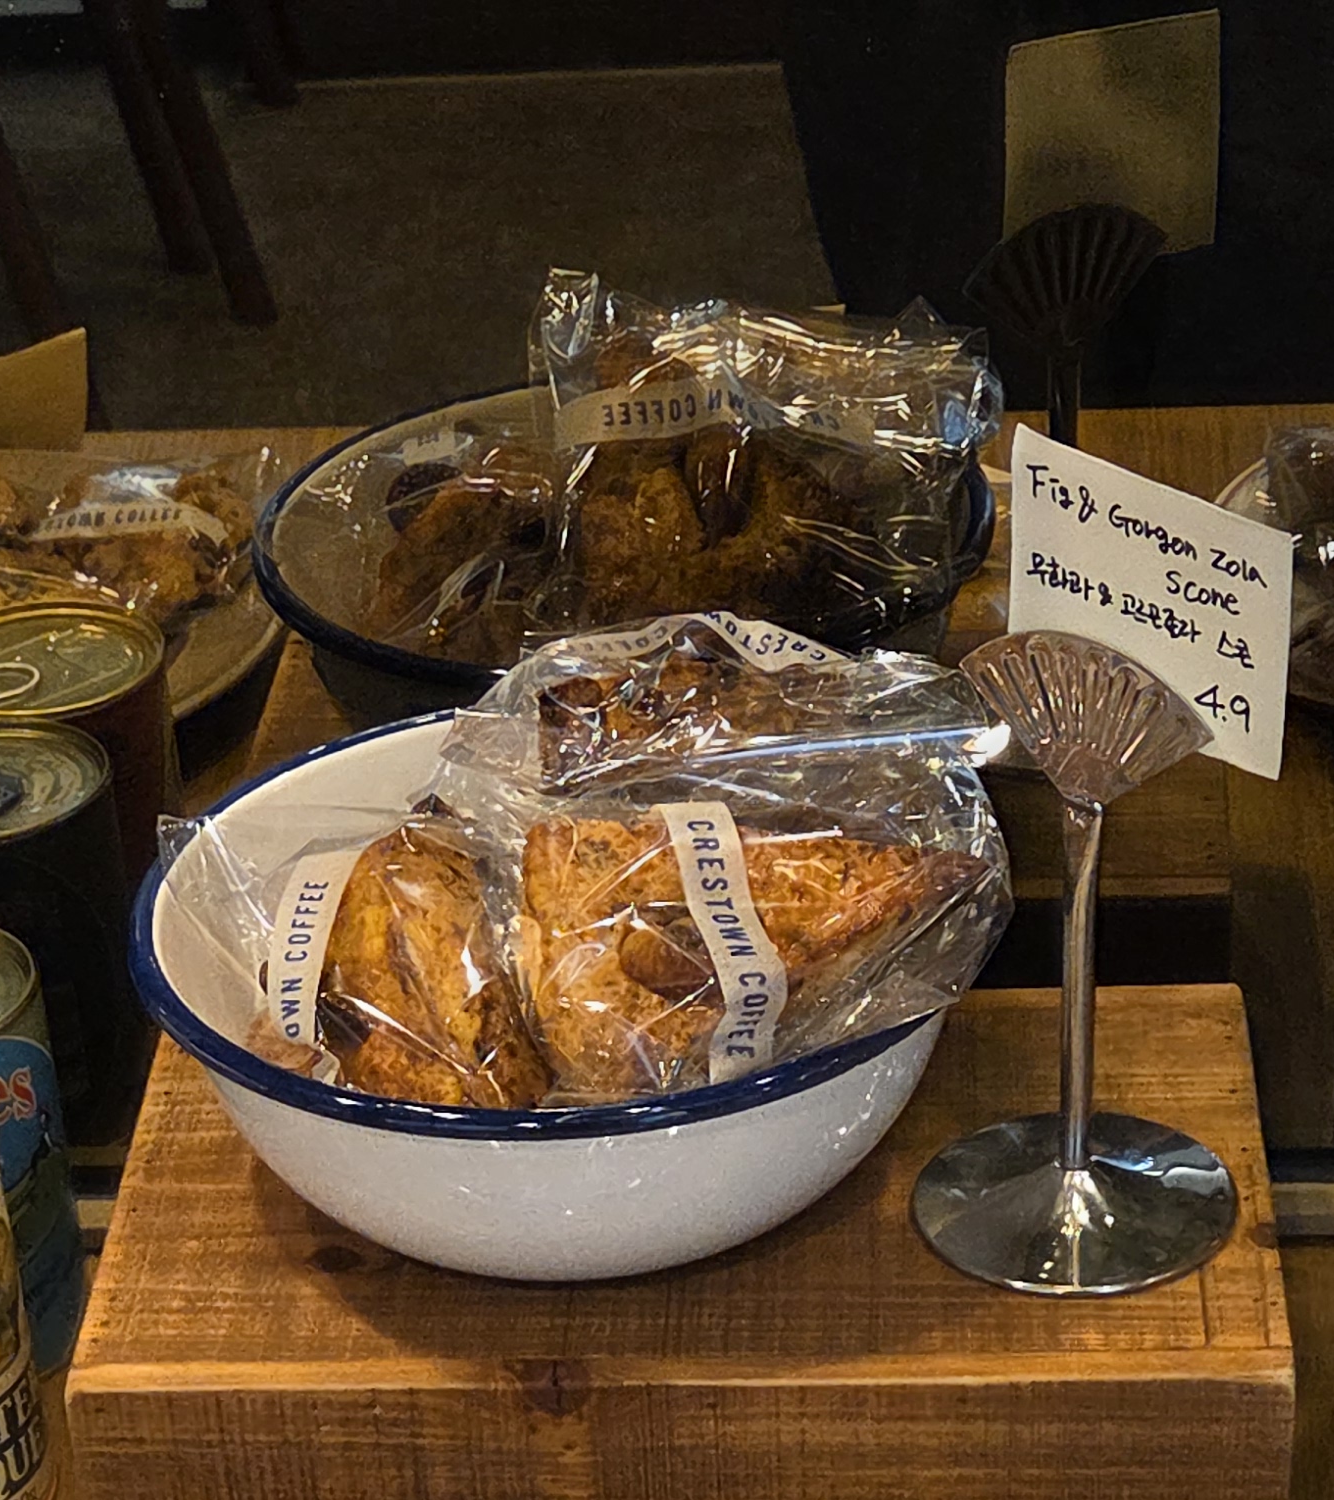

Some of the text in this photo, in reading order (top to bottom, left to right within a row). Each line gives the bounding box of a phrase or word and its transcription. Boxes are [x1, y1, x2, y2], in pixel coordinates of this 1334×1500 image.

[1026, 463, 1075, 510] Fig
[1195, 685, 1250, 733] 4.9
[284, 881, 329, 962] COFFEE
[687, 820, 768, 1059] CRESTOWN COFFEE
